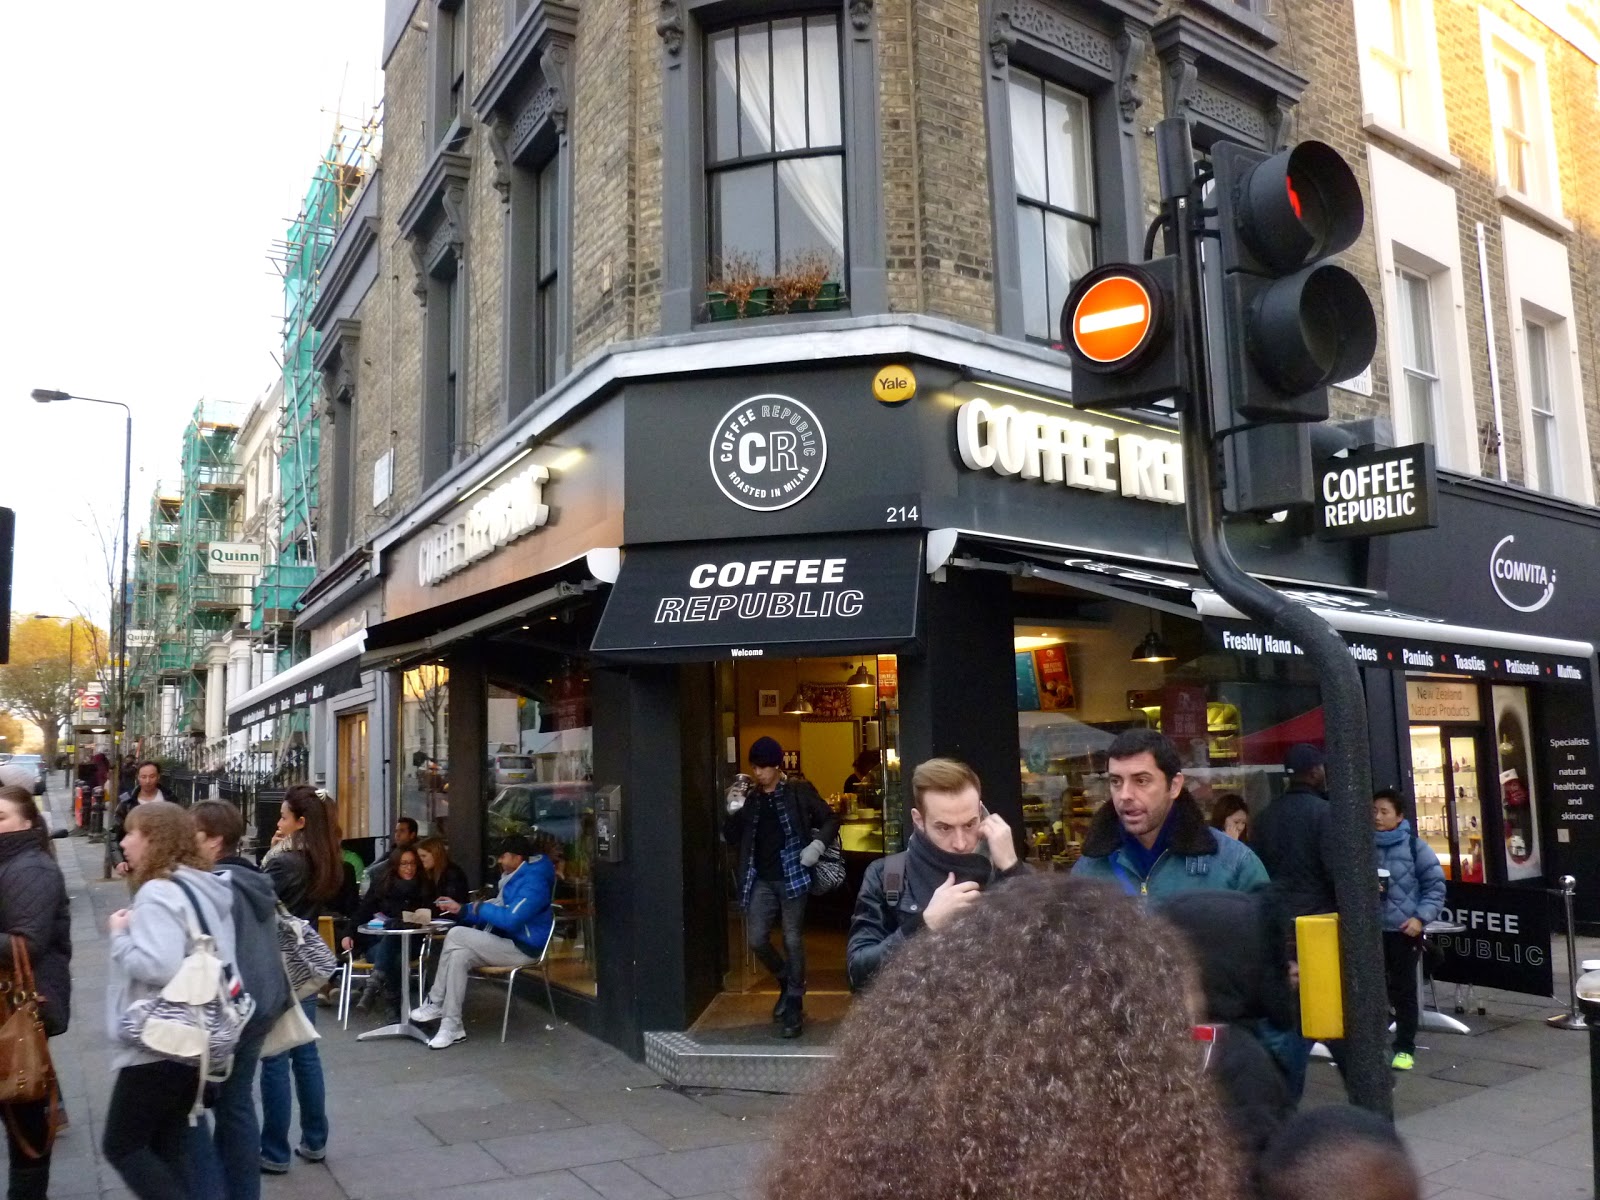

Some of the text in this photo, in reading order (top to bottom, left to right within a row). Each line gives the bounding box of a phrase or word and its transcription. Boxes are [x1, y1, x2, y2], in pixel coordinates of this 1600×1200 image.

[879, 377, 908, 390] Yale
[720, 404, 816, 463] COFFEE REPUBLIC
[738, 431, 799, 475] CR
[956, 398, 1117, 493] COFFEE
[728, 466, 810, 499] ROASTED IN MILAN
[1322, 457, 1416, 503] COFFEE
[886, 506, 919, 523] 214
[1324, 491, 1416, 528] REPUBLIC
[210, 548, 259, 563] Quinn
[689, 558, 847, 589] COFFEE
[1495, 558, 1548, 585] COMVITA
[654, 590, 864, 623] REPUBLIC
[126, 633, 156, 642] Quinn
[730, 648, 764, 657] Welcome
[1222, 631, 1262, 655] Freshly
[1402, 648, 1434, 667] Paninis
[1454, 654, 1486, 671] Toasties
[1505, 659, 1540, 676] Patisserie
[1557, 664, 1582, 680] Muffins
[1416, 686, 1463, 700] New Zealand
[1411, 703, 1471, 718] Natural Products
[1549, 738, 1590, 748] Specialists
[1558, 767, 1587, 776] natural
[1553, 782, 1595, 791] healthcare
[1567, 797, 1583, 805] and
[1561, 812, 1595, 820] skincare
[1438, 907, 1520, 934] OFFEE
[1427, 934, 1544, 966] PUBLIC
